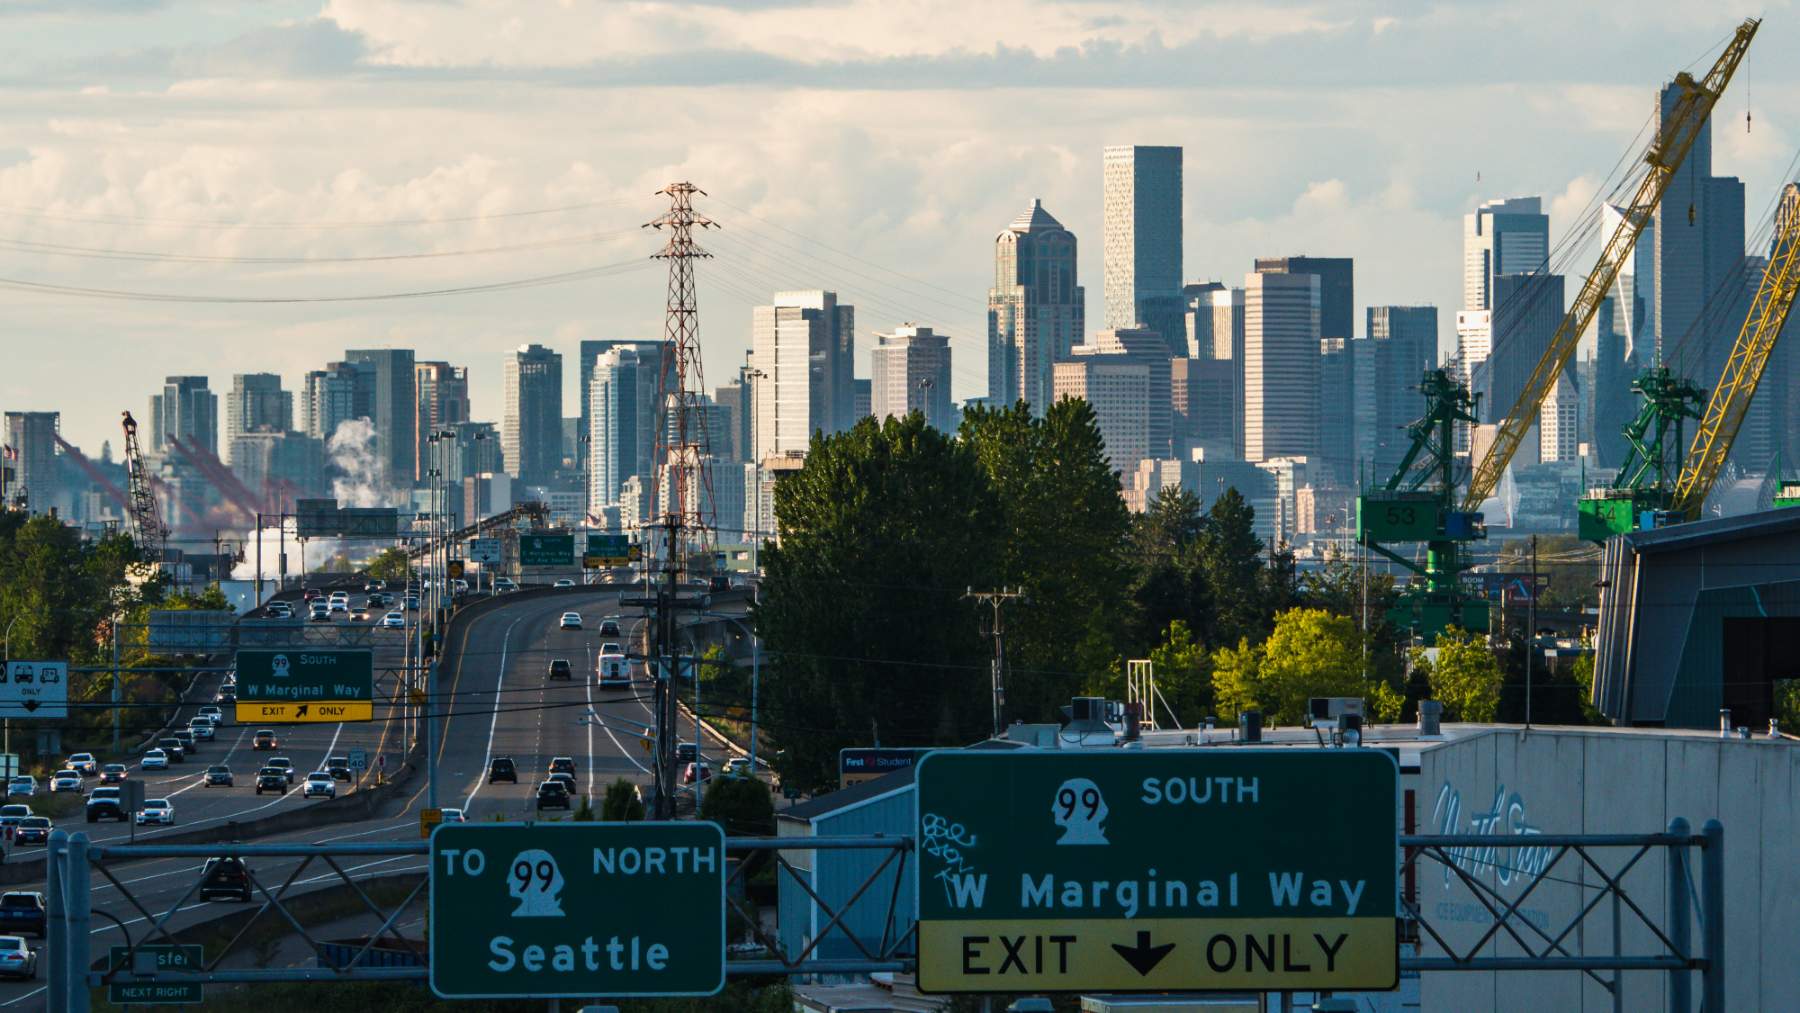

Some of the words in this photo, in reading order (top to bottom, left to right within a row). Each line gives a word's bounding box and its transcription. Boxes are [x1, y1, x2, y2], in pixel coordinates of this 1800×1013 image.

[1386, 507, 1416, 525] 53
[1595, 506, 1617, 523] 54
[274, 658, 287, 667] 99
[299, 654, 337, 665] SOUTH
[21, 688, 41, 696] ONLY
[248, 684, 259, 696] W
[265, 684, 324, 698] Marginal
[333, 684, 361, 698] Way
[262, 707, 286, 716] EXIT
[319, 707, 346, 716] ONLY
[352, 760, 364, 768] 40
[846, 757, 865, 767] First
[877, 757, 912, 767] Student
[1057, 788, 1101, 822] 99
[1141, 777, 1260, 805] SOUTH
[440, 849, 485, 876] TO
[514, 860, 555, 894] 99
[593, 847, 716, 875] NORTH
[952, 873, 988, 908] W
[1021, 867, 1239, 919] Marginal
[1268, 871, 1367, 916] Way
[487, 935, 670, 973] Seattle
[962, 935, 1077, 975] EXIT
[1206, 933, 1349, 974] ONLY
[121, 987, 153, 998] NEXT
[156, 987, 190, 998] RIGHT
